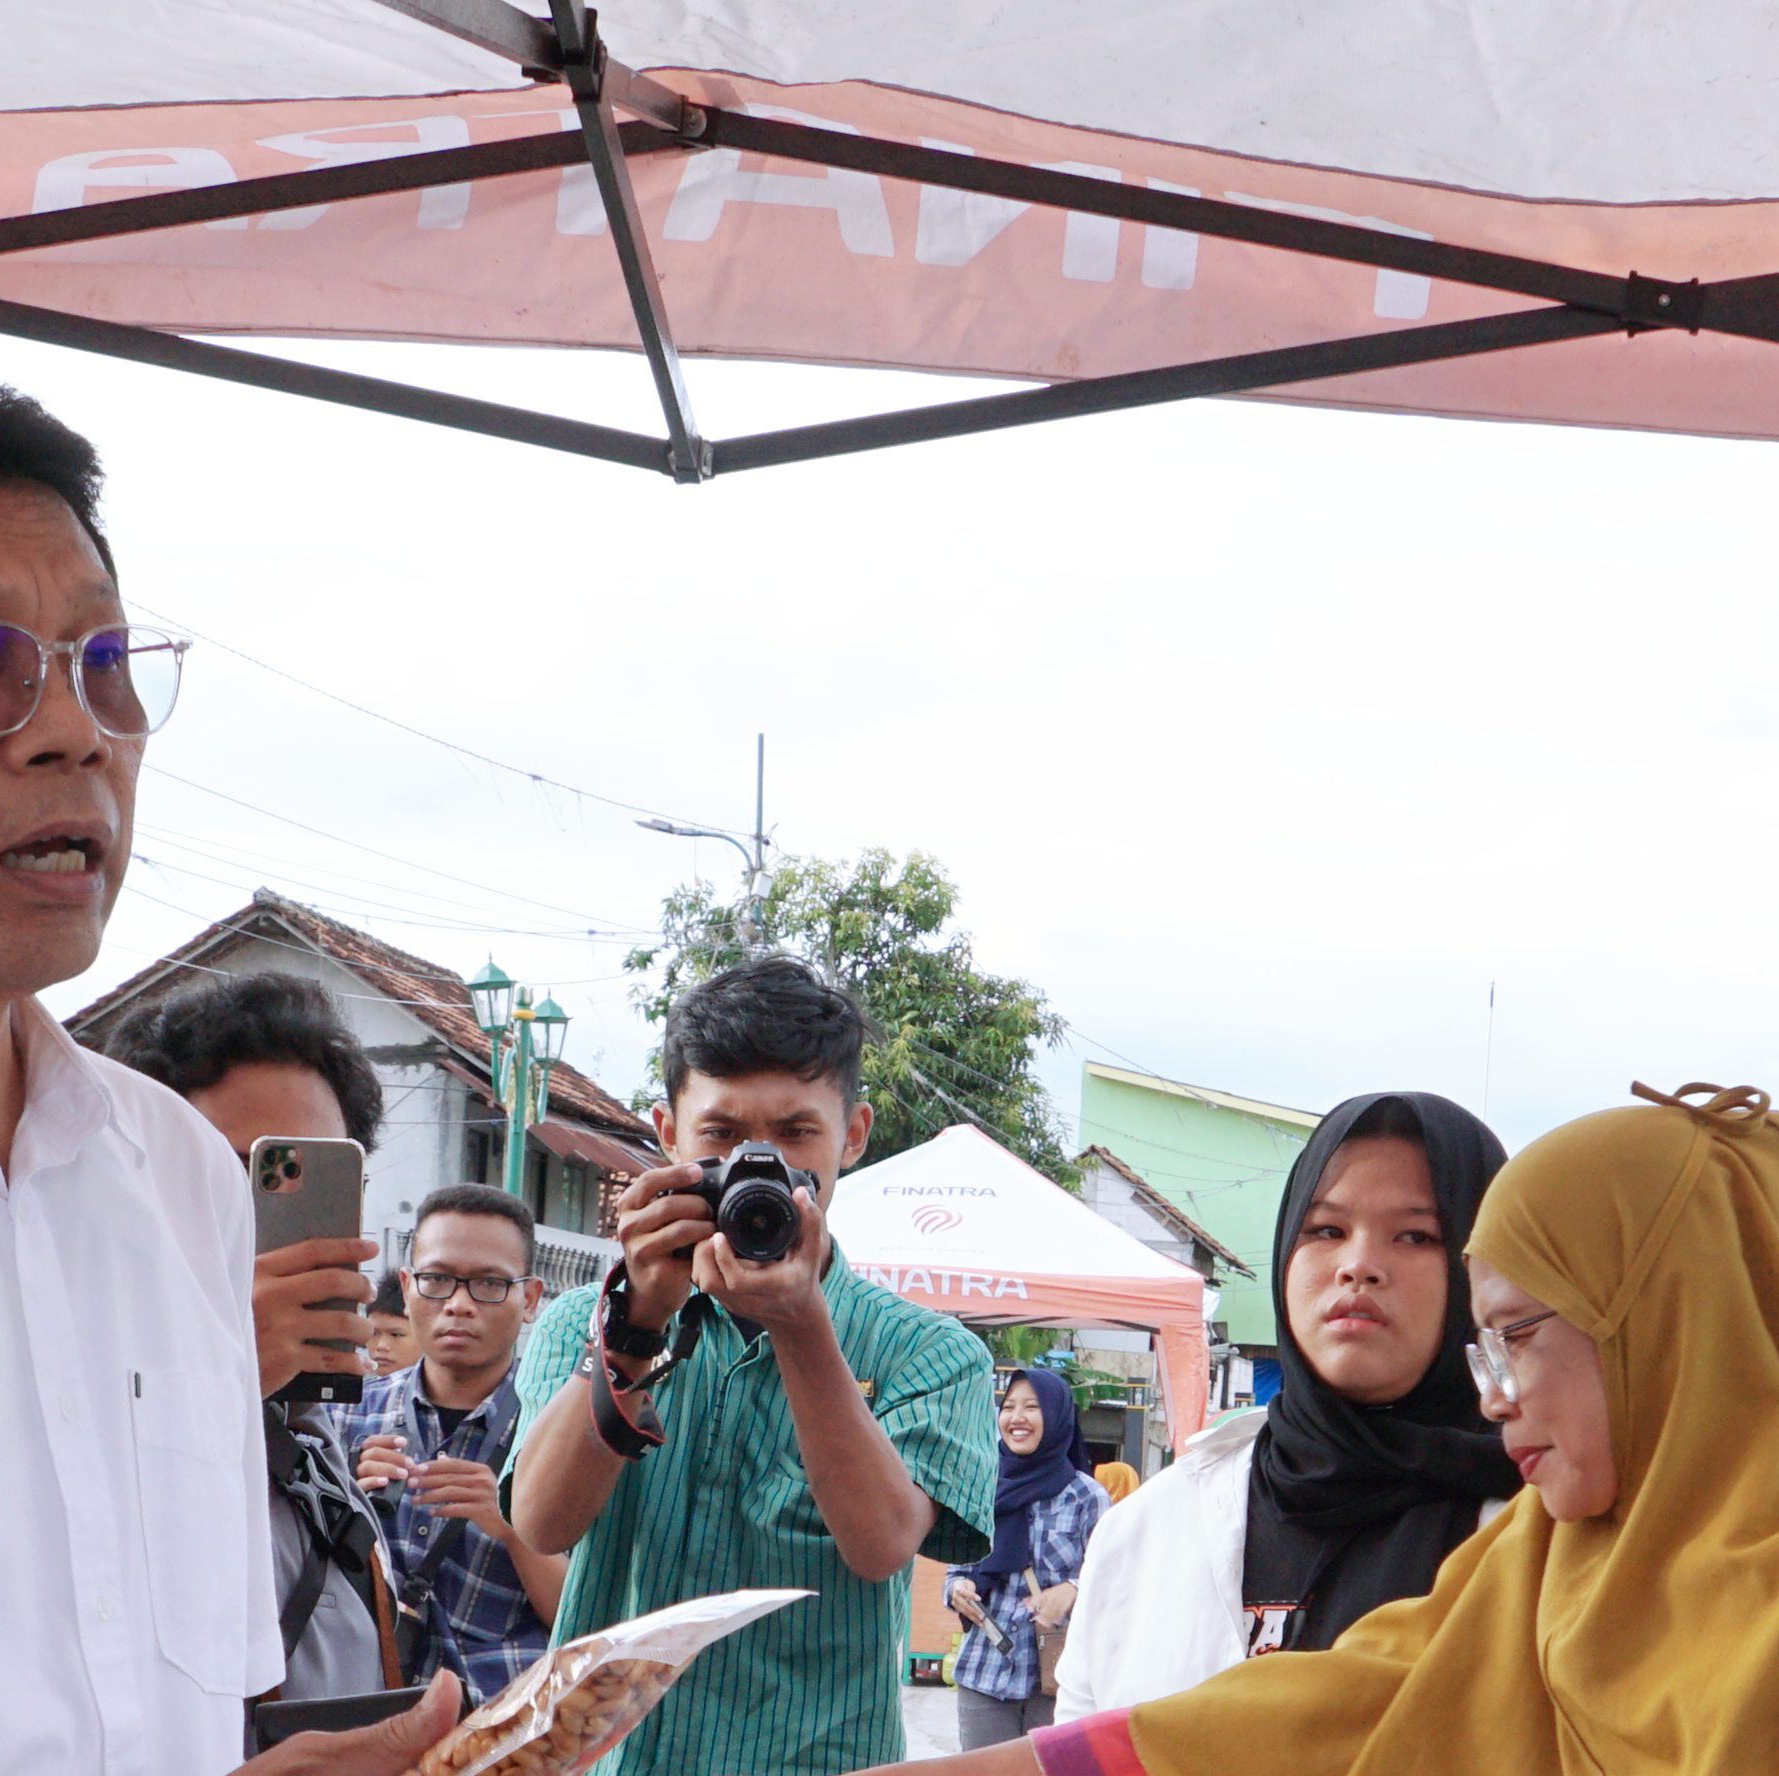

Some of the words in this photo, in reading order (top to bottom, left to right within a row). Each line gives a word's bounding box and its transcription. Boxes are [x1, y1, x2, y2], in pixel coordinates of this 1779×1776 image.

[744, 1154, 774, 1163] Canon
[883, 1186, 997, 1197] FINATRA
[850, 1267, 1029, 1299] INATRA
